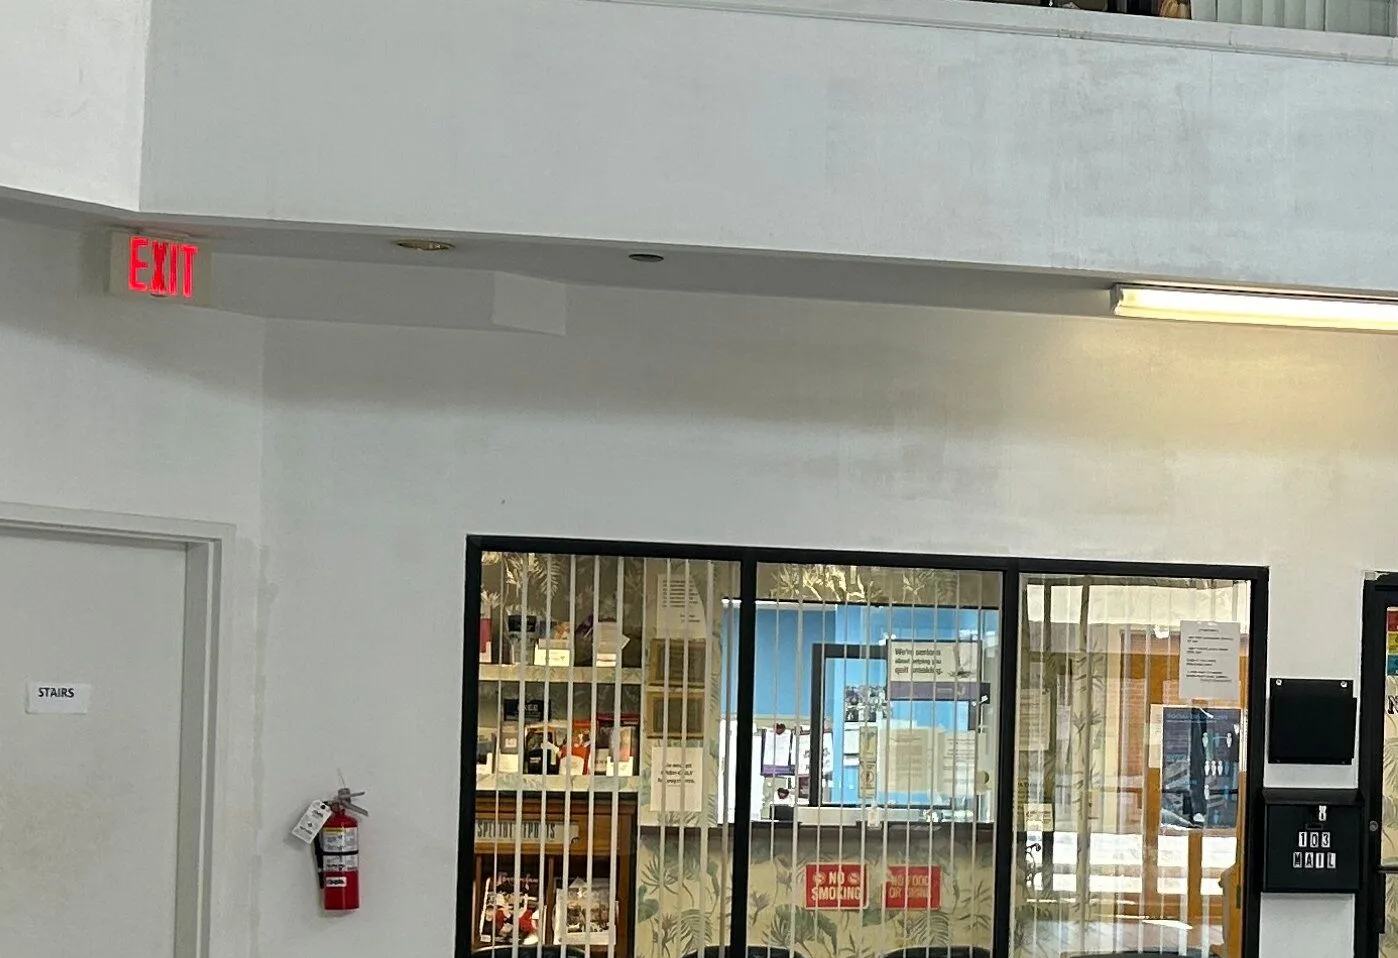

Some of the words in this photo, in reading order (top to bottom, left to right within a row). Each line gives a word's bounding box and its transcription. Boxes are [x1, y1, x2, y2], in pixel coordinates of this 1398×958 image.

[129, 235, 198, 298] EXIT
[38, 687, 75, 698] STAIRS
[1299, 832, 1331, 848] 103
[1293, 852, 1337, 869] MAIL
[828, 871, 846, 885] NO
[811, 886, 861, 901] SMOKING
